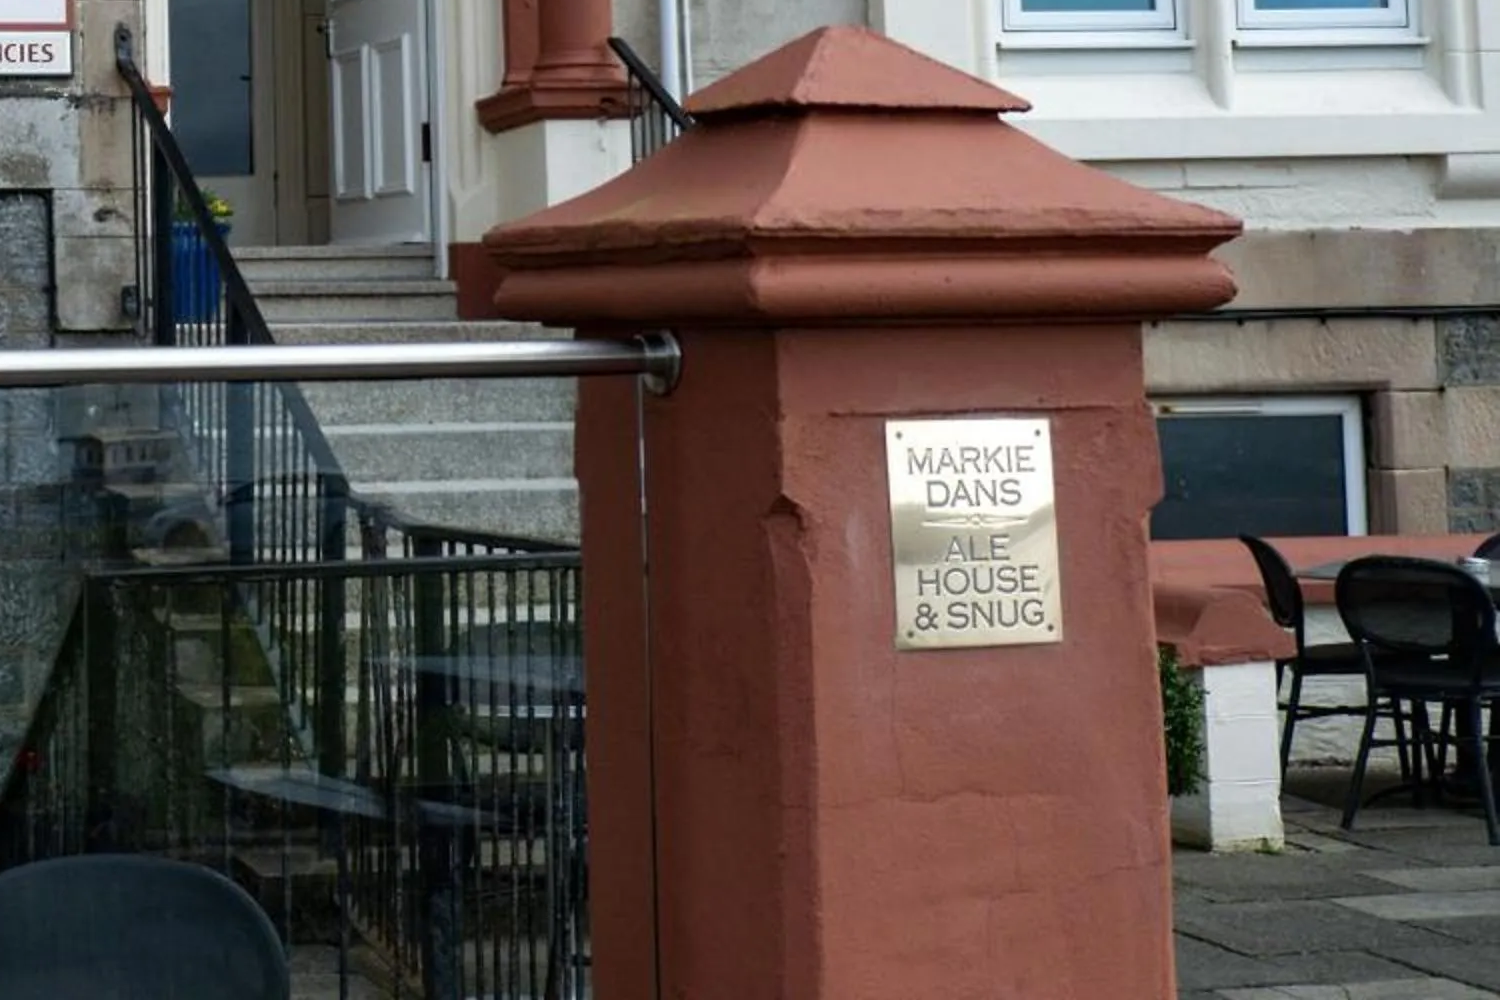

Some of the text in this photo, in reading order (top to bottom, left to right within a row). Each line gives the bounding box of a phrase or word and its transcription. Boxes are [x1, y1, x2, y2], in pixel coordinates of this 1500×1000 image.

[907, 446, 1036, 475] MARKIE
[926, 478, 1022, 508] DANS
[945, 533, 1010, 562] ALE
[917, 565, 1040, 596] HOUSE
[915, 599, 1045, 631] & SNUG
